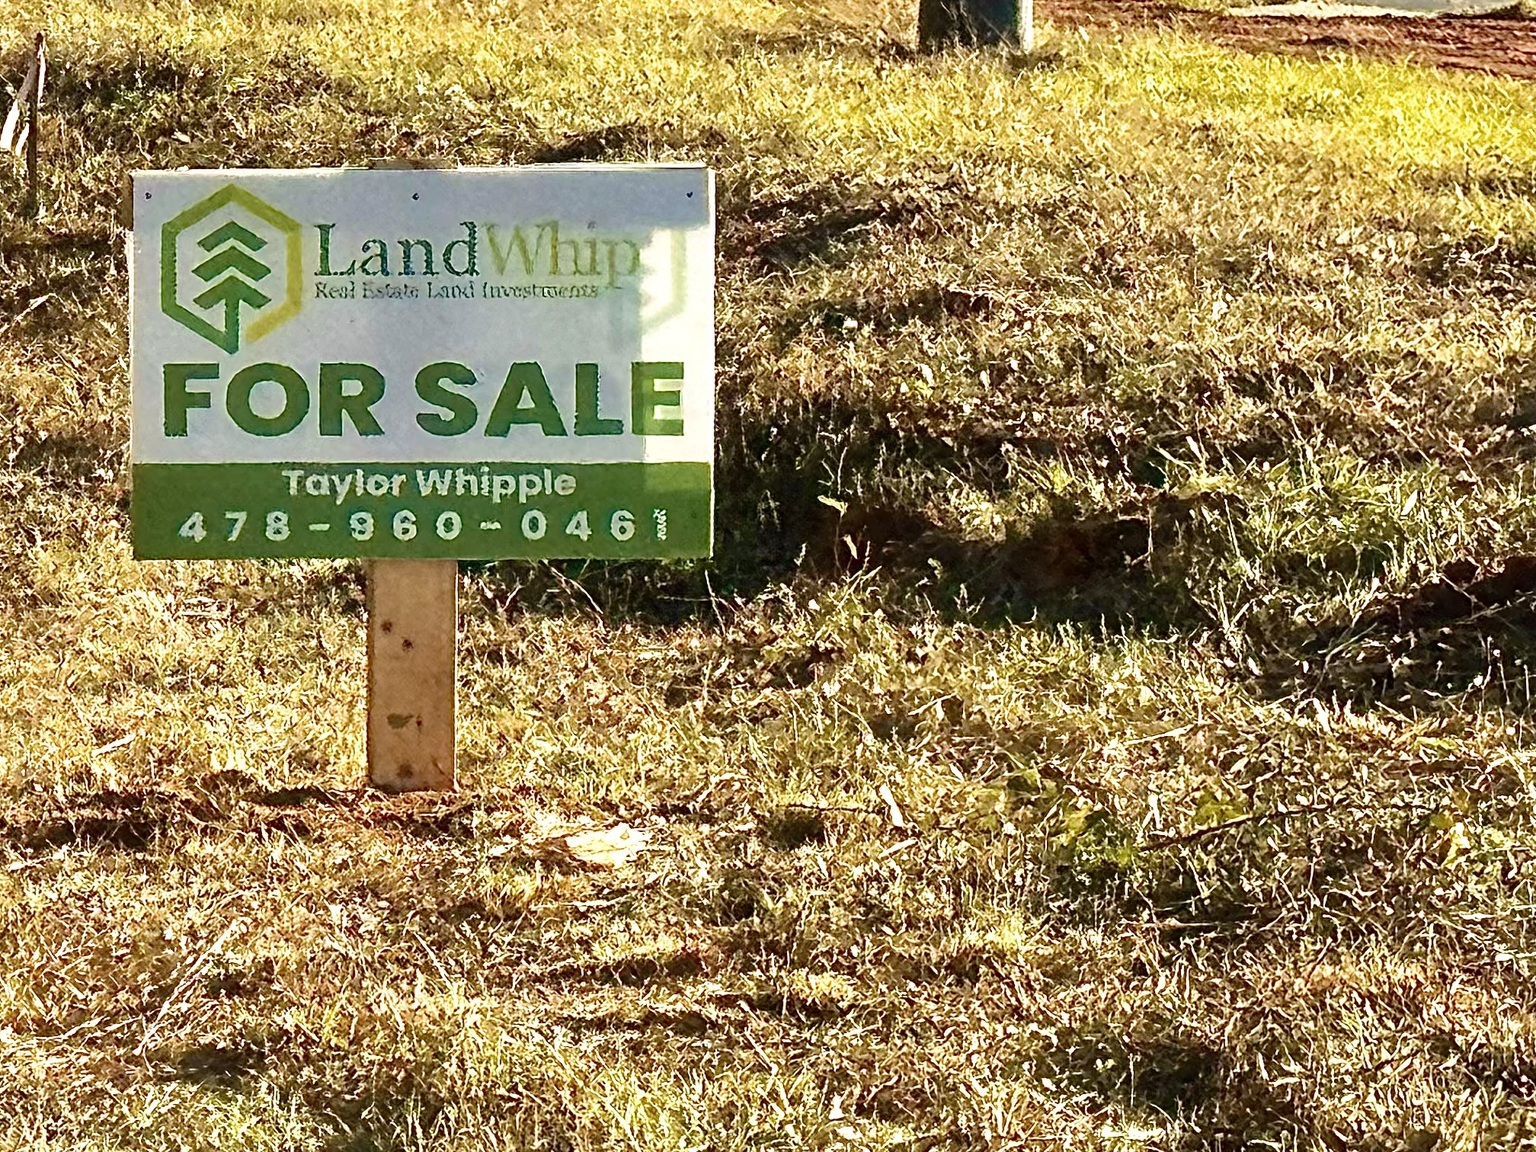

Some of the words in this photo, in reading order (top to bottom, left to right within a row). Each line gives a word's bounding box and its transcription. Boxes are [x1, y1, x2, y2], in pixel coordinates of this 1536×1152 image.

[314, 220, 642, 291] LandWhip
[314, 281, 356, 300] Real
[362, 281, 419, 300] Estate
[427, 281, 476, 300] Land
[482, 281, 600, 300] Investments
[162, 362, 386, 438] FOR
[414, 361, 686, 438] SALE
[282, 468, 407, 505] Taylor
[416, 466, 578, 504] Whipple
